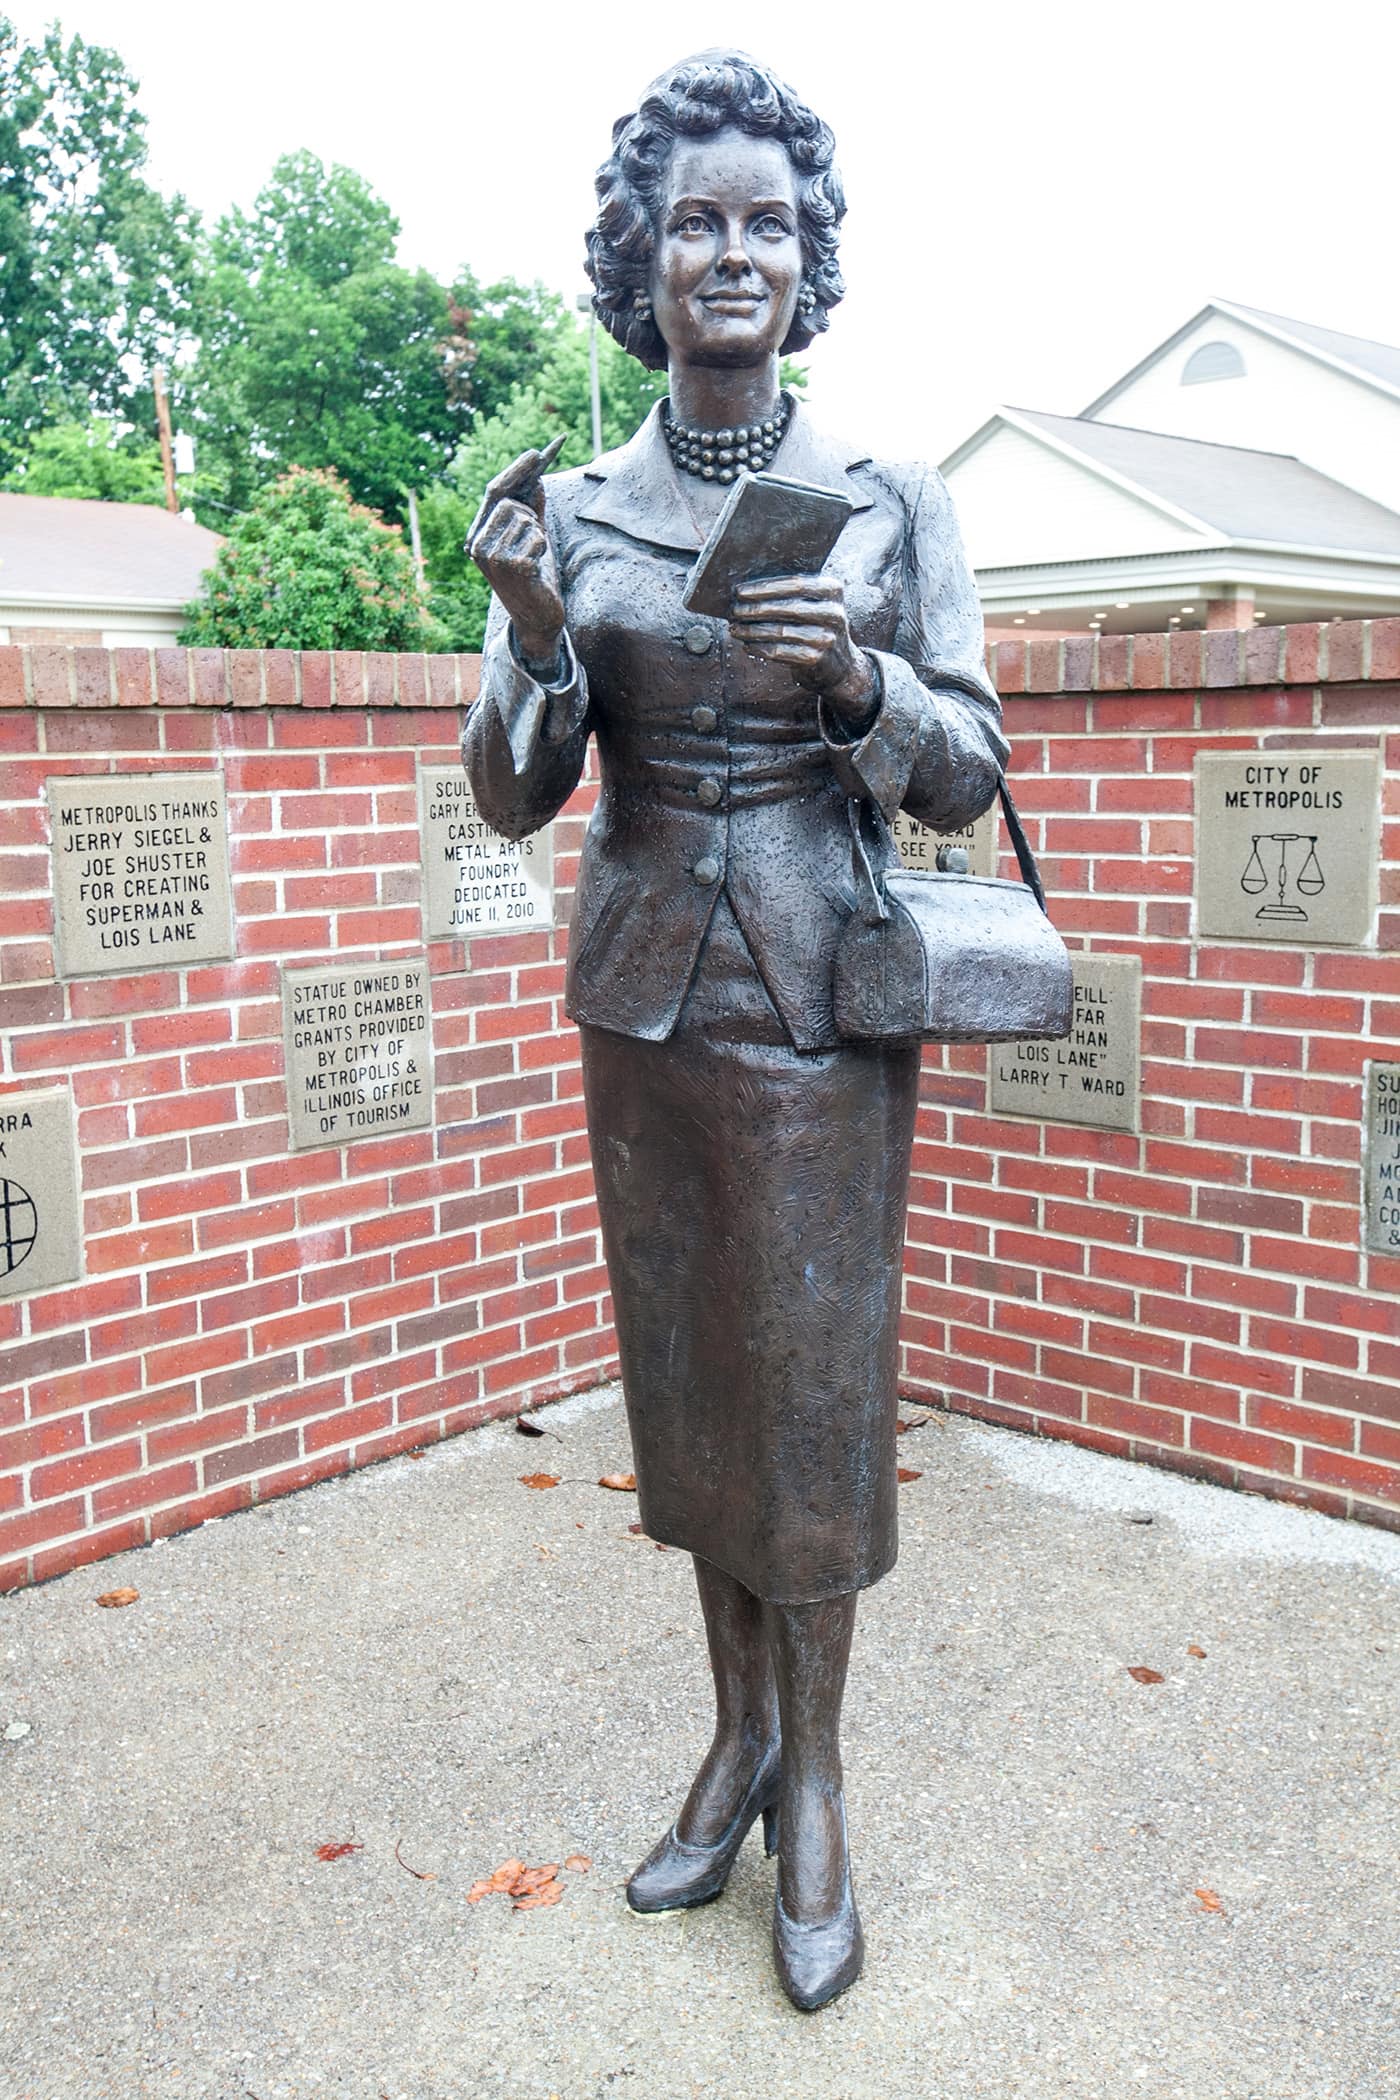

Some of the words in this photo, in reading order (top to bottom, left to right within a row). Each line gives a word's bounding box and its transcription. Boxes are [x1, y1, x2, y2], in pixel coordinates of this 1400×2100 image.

[1246, 766, 1289, 784] CITY
[1300, 766, 1322, 783] OF
[436, 781, 470, 798] SCUL
[1225, 791, 1343, 808] METROPOLIS
[61, 804, 157, 826] METROPOLIS
[162, 800, 218, 820] THANKS
[429, 803, 459, 820] GARY
[64, 832, 122, 852] JERRY
[134, 828, 194, 848] SIEGEL
[199, 827, 212, 843] &
[448, 823, 500, 840] CASTIN
[445, 844, 491, 861] METAL
[499, 840, 534, 857] ARTS
[901, 841, 927, 857] SEE
[82, 858, 116, 877] JOE
[126, 851, 206, 874] SHUSTER
[460, 863, 520, 881] FOUNDRY
[80, 882, 114, 901] FOR
[124, 874, 210, 898] CREATING
[455, 882, 527, 903] DEDICATED
[86, 900, 185, 926] SUPERMAN
[191, 899, 204, 916] &
[449, 907, 482, 925] JUNE
[507, 902, 535, 919] 2010
[100, 928, 140, 949] LOIS
[150, 923, 196, 944] LANE
[294, 982, 346, 1003] STATUE
[354, 975, 399, 996] OWNED
[406, 973, 421, 989] BY
[294, 1004, 347, 1025] METRO
[355, 994, 423, 1017] CHAMBER
[1076, 1008, 1105, 1026] FAR
[295, 1026, 352, 1048] GRANTS
[359, 1015, 425, 1039] PROVIDED
[318, 1051, 336, 1067] BY
[345, 1043, 379, 1063] CITY
[388, 1039, 405, 1056] OF
[1017, 1044, 1049, 1063] LOIS
[305, 1061, 400, 1091] METROPOLIS
[407, 1059, 417, 1074] &
[1000, 1067, 1050, 1086] LARRY
[1081, 1076, 1125, 1097] WARD
[304, 1089, 365, 1114] ILLINOIS
[373, 1079, 422, 1101] OFFICE
[320, 1115, 337, 1133] OF
[347, 1102, 410, 1127] TOURISM
